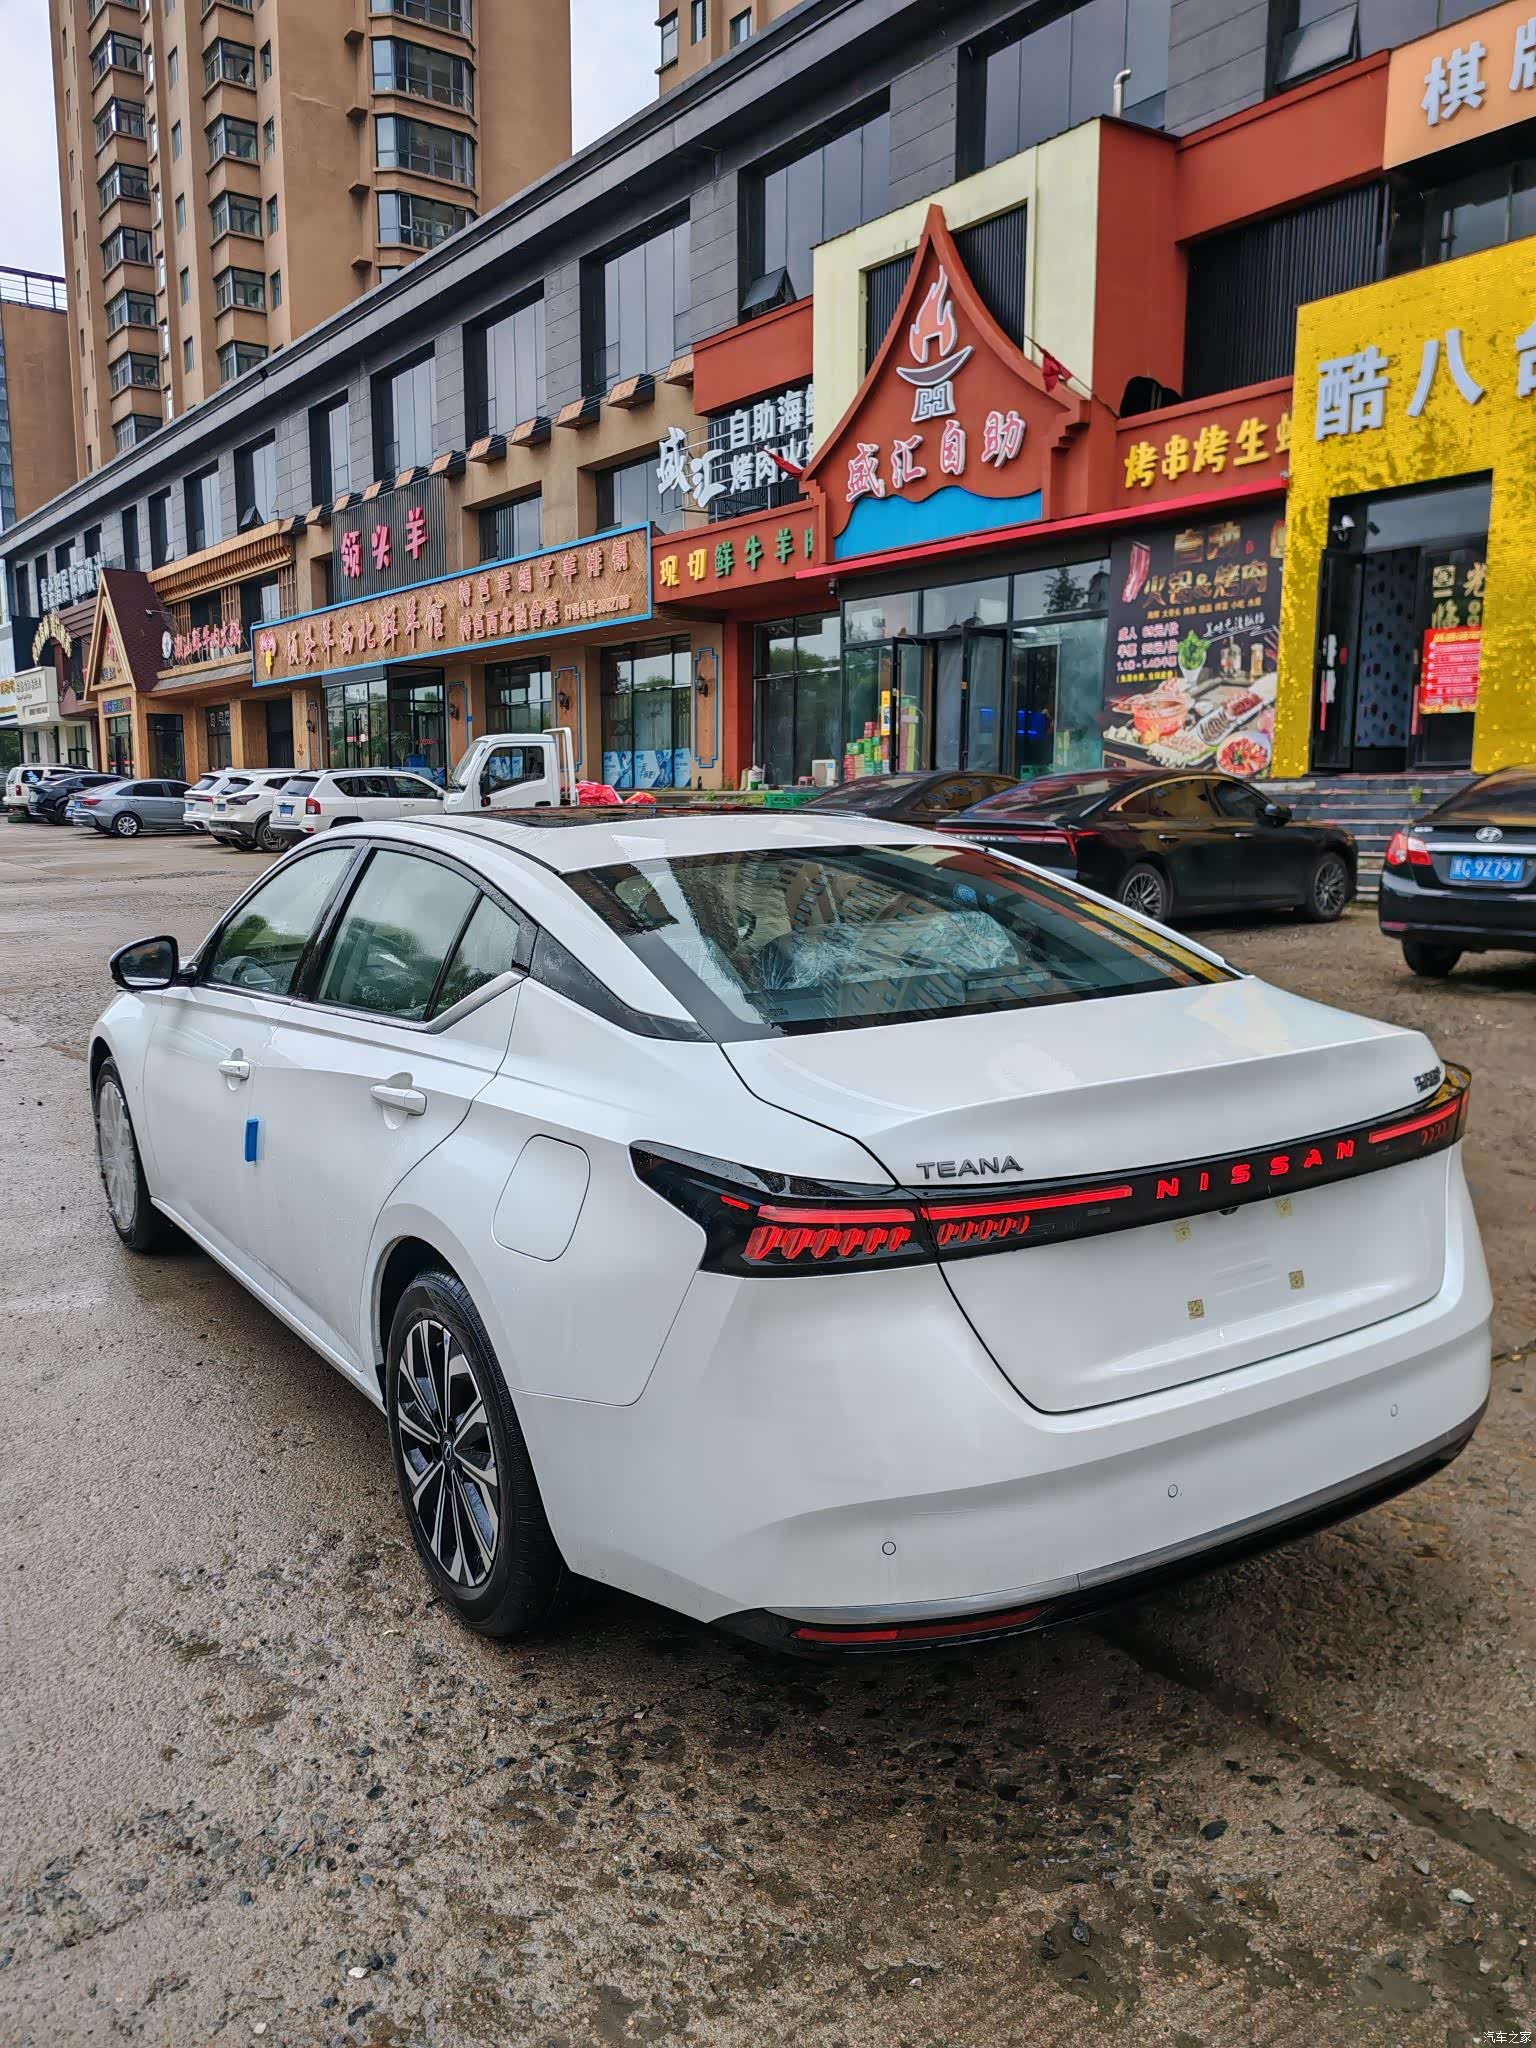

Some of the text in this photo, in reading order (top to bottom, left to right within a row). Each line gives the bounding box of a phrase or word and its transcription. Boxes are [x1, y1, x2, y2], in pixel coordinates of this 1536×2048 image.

[656, 426, 727, 508] 盛汇
[730, 433, 815, 495] 烤肉火
[846, 410, 1027, 503] 盛汇自助
[341, 506, 429, 578] 领头羊
[286, 594, 446, 666] 领头羊西北鲜羊馆
[916, 1154, 1024, 1180] TEANA
[1156, 1139, 1355, 1199] NISSAN
